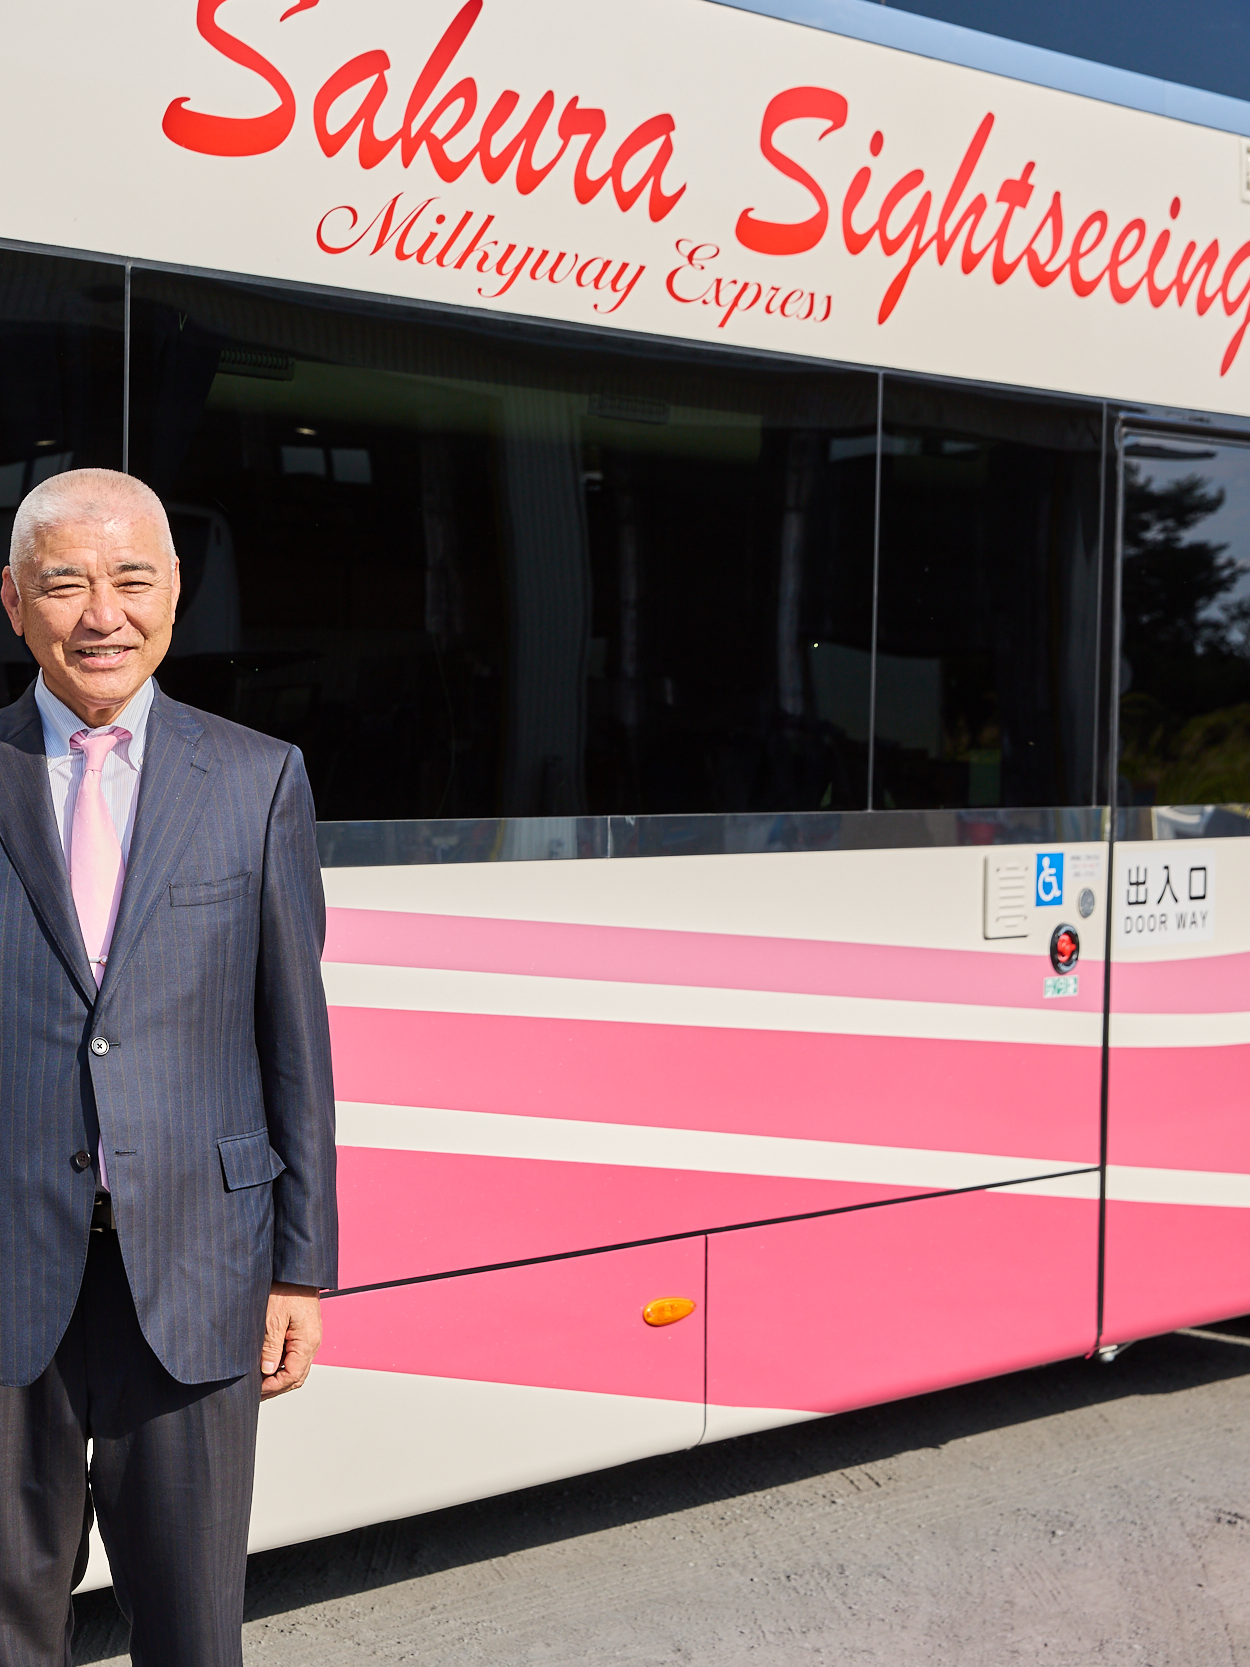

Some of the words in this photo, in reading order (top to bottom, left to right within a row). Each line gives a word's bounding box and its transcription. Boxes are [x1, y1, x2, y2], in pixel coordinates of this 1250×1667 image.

[161, 0, 687, 223] Sakura
[735, 86, 1250, 377] Sightseeing
[316, 192, 646, 314] Milkyway
[665, 238, 833, 329] Express
[1125, 913, 1169, 935] DOOR
[1175, 910, 1210, 931] WAY
[1126, 864, 1208, 906] 出入口
